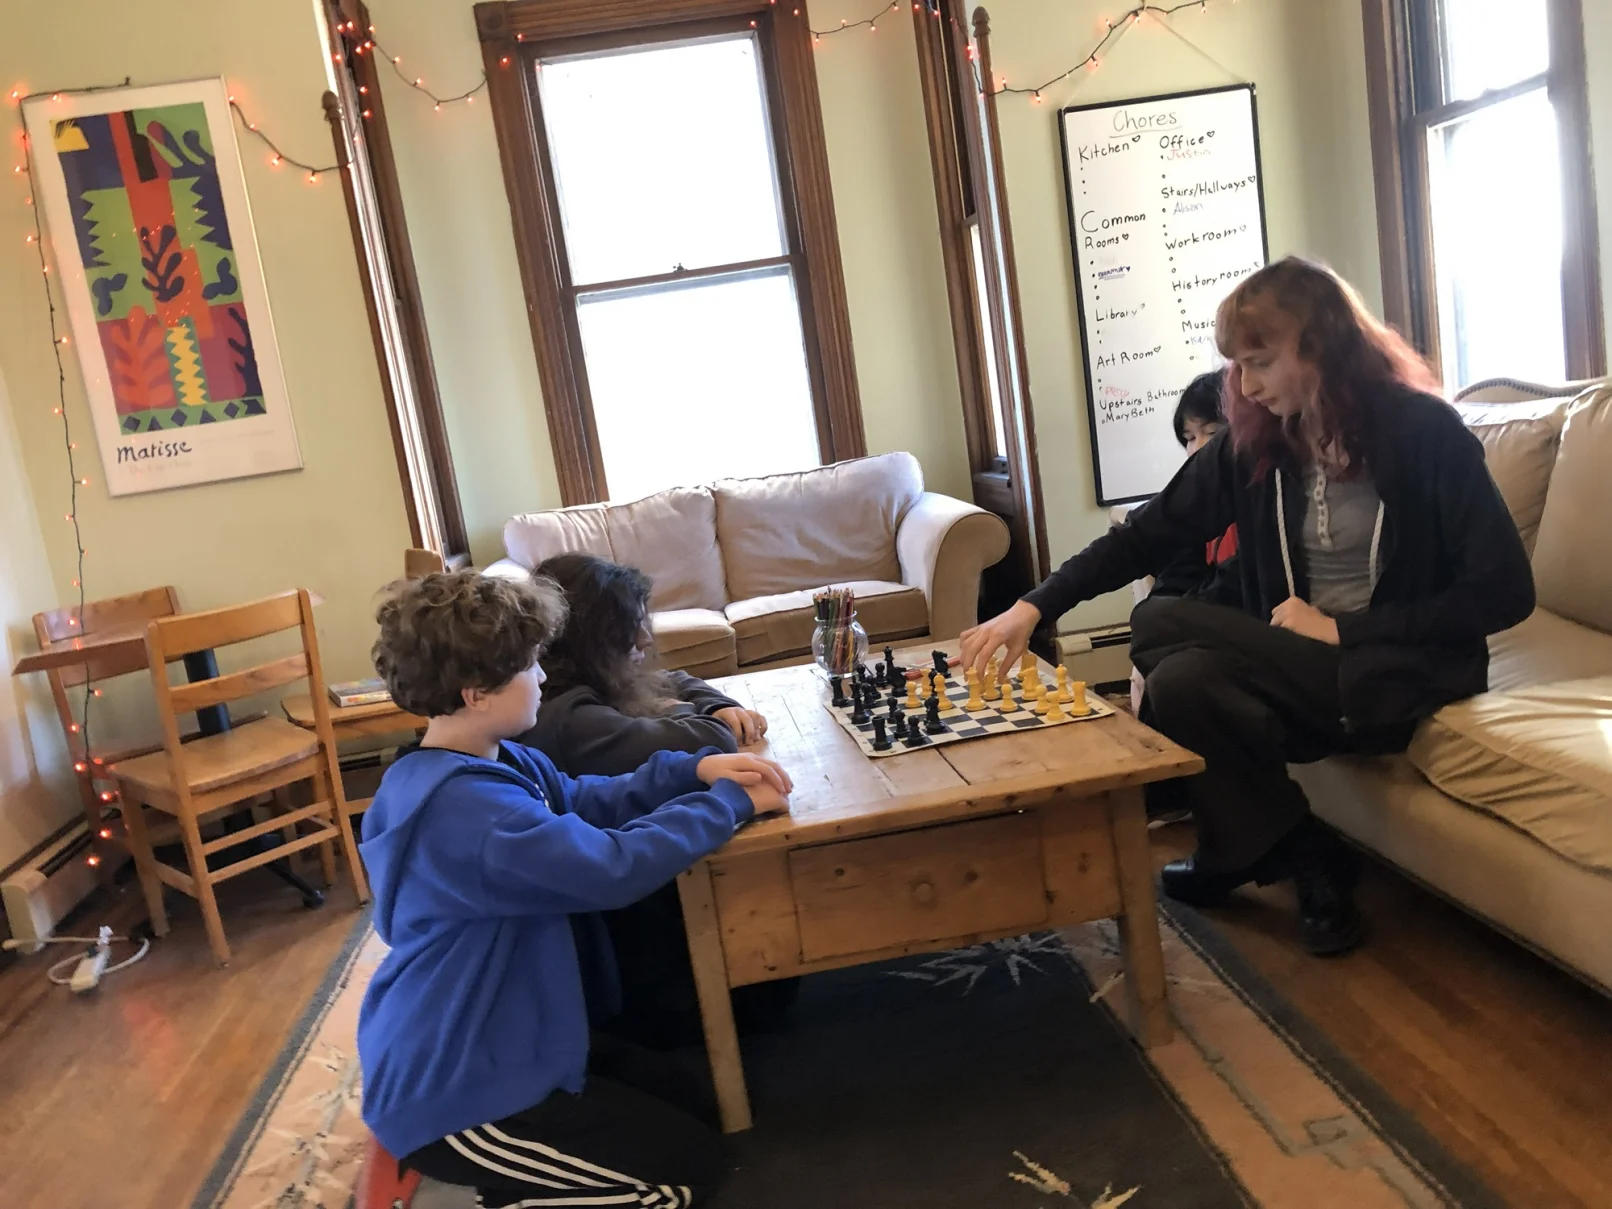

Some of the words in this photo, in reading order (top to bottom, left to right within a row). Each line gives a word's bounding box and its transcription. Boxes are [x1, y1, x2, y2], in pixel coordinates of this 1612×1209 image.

[1113, 110, 1178, 132] Chores
[1159, 134, 1205, 149] Office
[1079, 142, 1130, 163] Kitchen
[1161, 180, 1246, 199] Stairs/Hallways
[1081, 210, 1146, 233] Common
[1085, 236, 1119, 249] Rooms
[1096, 307, 1138, 322] Library
[1182, 319, 1216, 332] Music
[1097, 354, 1116, 369] Art
[1121, 349, 1153, 366] Room
[1099, 397, 1142, 411] Upstairs
